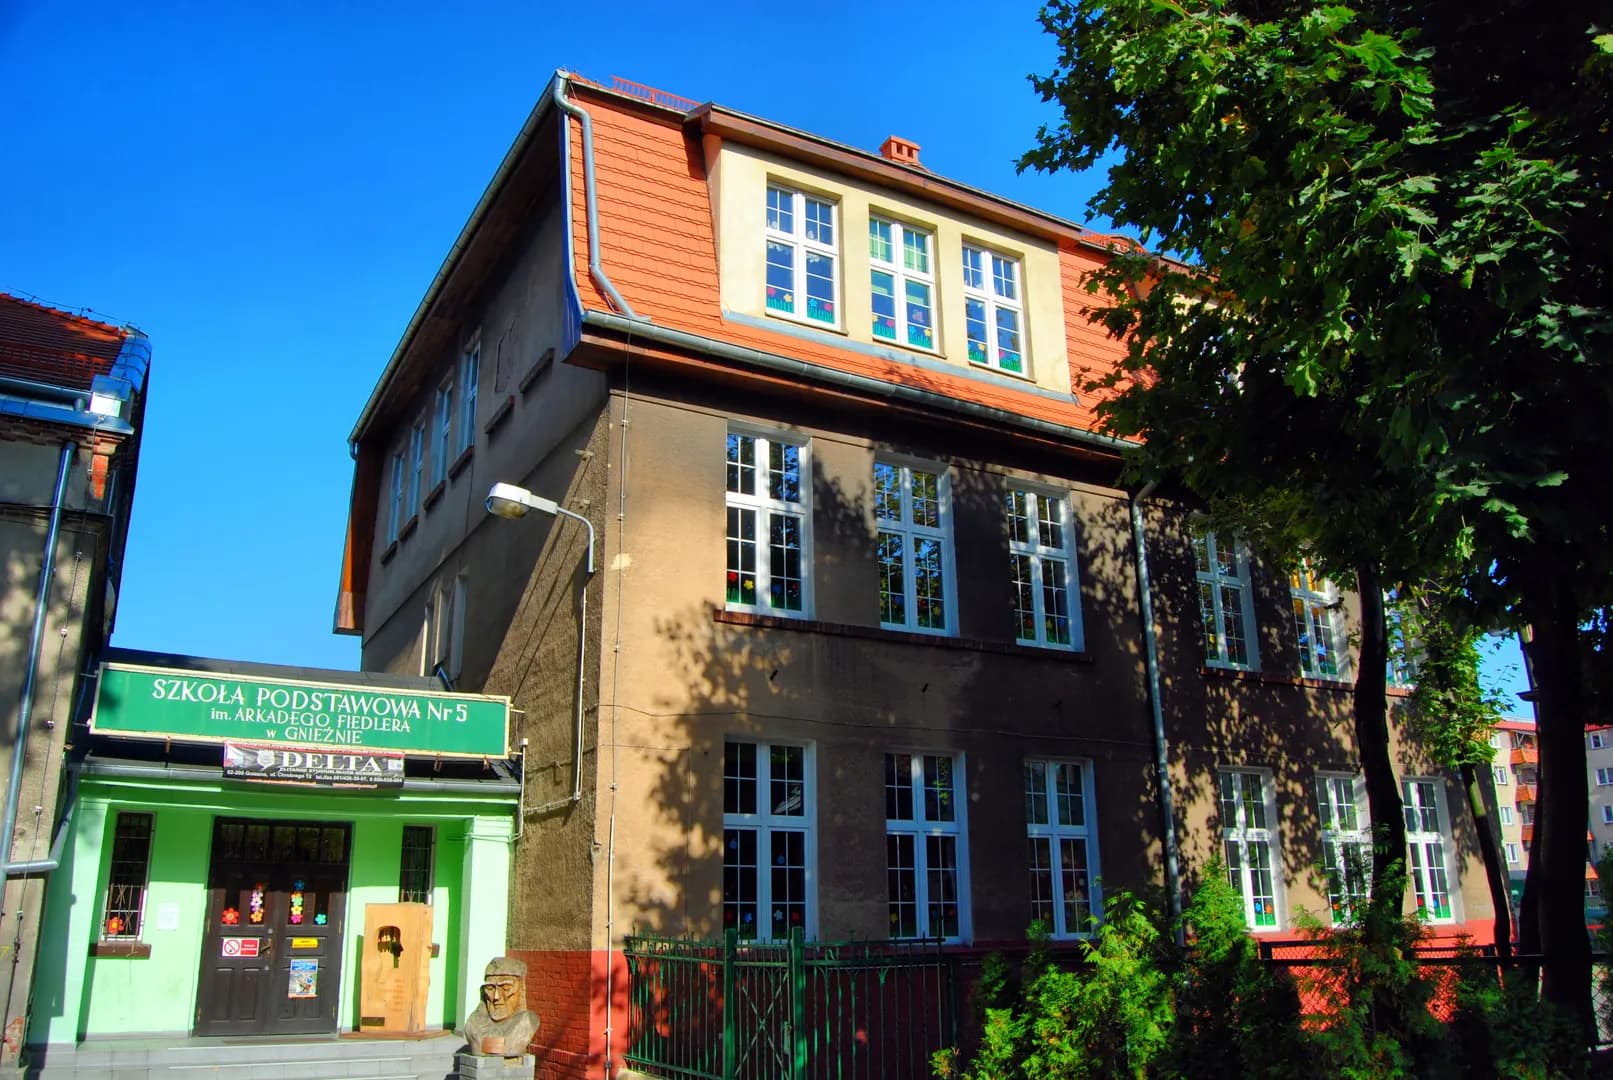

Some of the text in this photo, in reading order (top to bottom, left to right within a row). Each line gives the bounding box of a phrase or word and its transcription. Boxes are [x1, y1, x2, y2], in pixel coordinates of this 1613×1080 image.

[152, 678, 468, 723] SZKOŁA PODSTAWOWA Nr 5
[210, 707, 411, 733] im. ARKADEGO FIEDLERA
[266, 726, 362, 744] w GNIEŹNIE
[283, 751, 382, 772] DELTA
